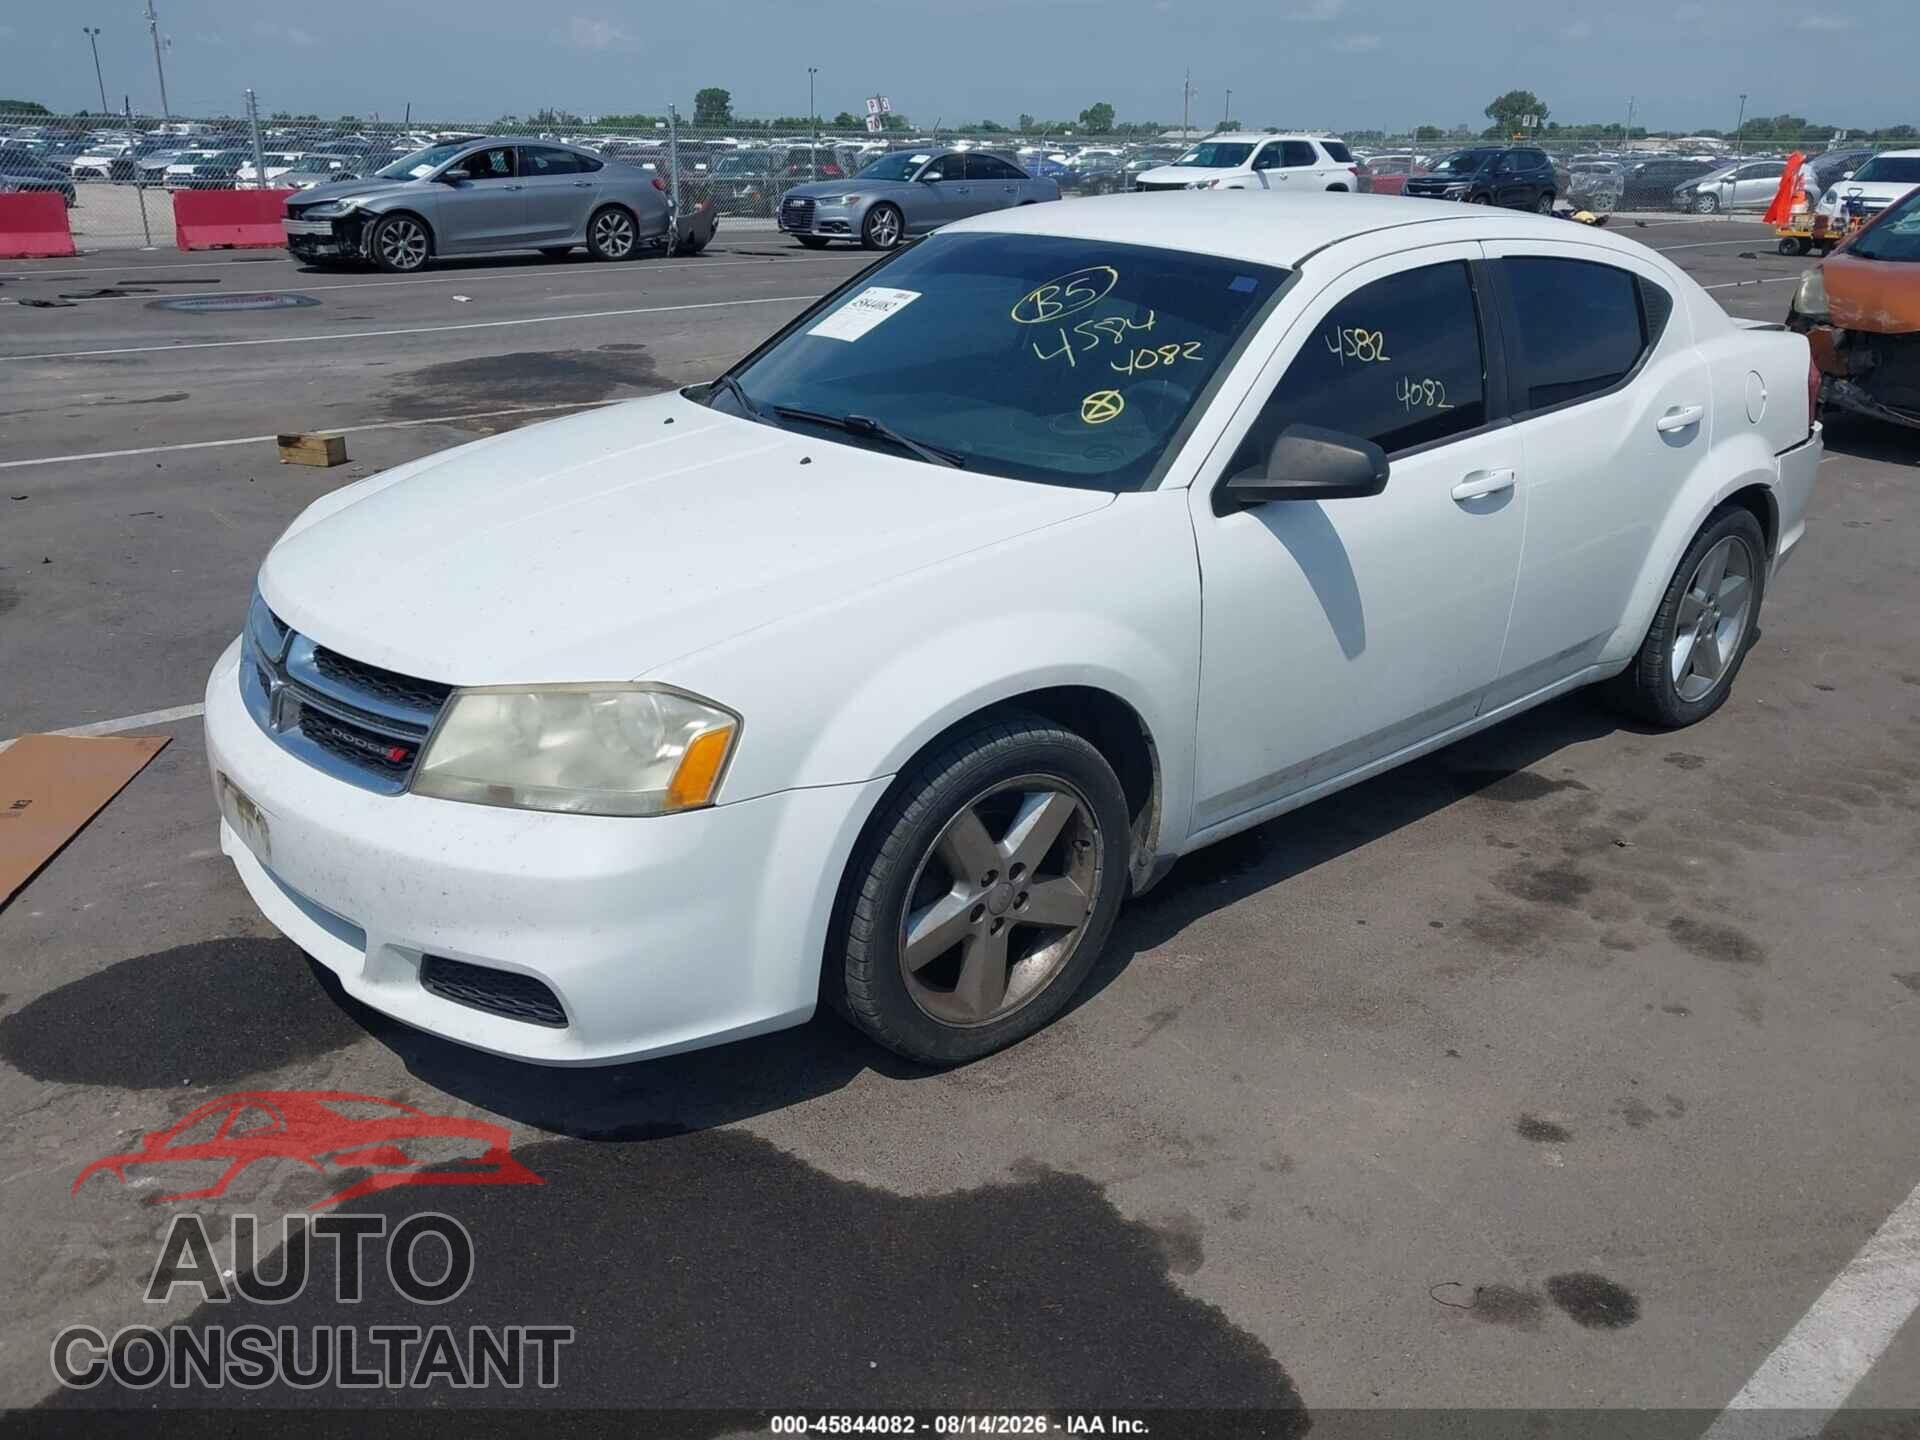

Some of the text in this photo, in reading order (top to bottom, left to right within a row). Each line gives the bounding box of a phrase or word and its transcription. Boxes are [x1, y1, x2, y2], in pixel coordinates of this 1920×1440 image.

[1029, 277, 1096, 320] B5
[1033, 309, 1156, 367] 4584
[1110, 341, 1204, 376] 4082
[1324, 325, 1391, 367] 4582
[1396, 375, 1455, 413] 4082
